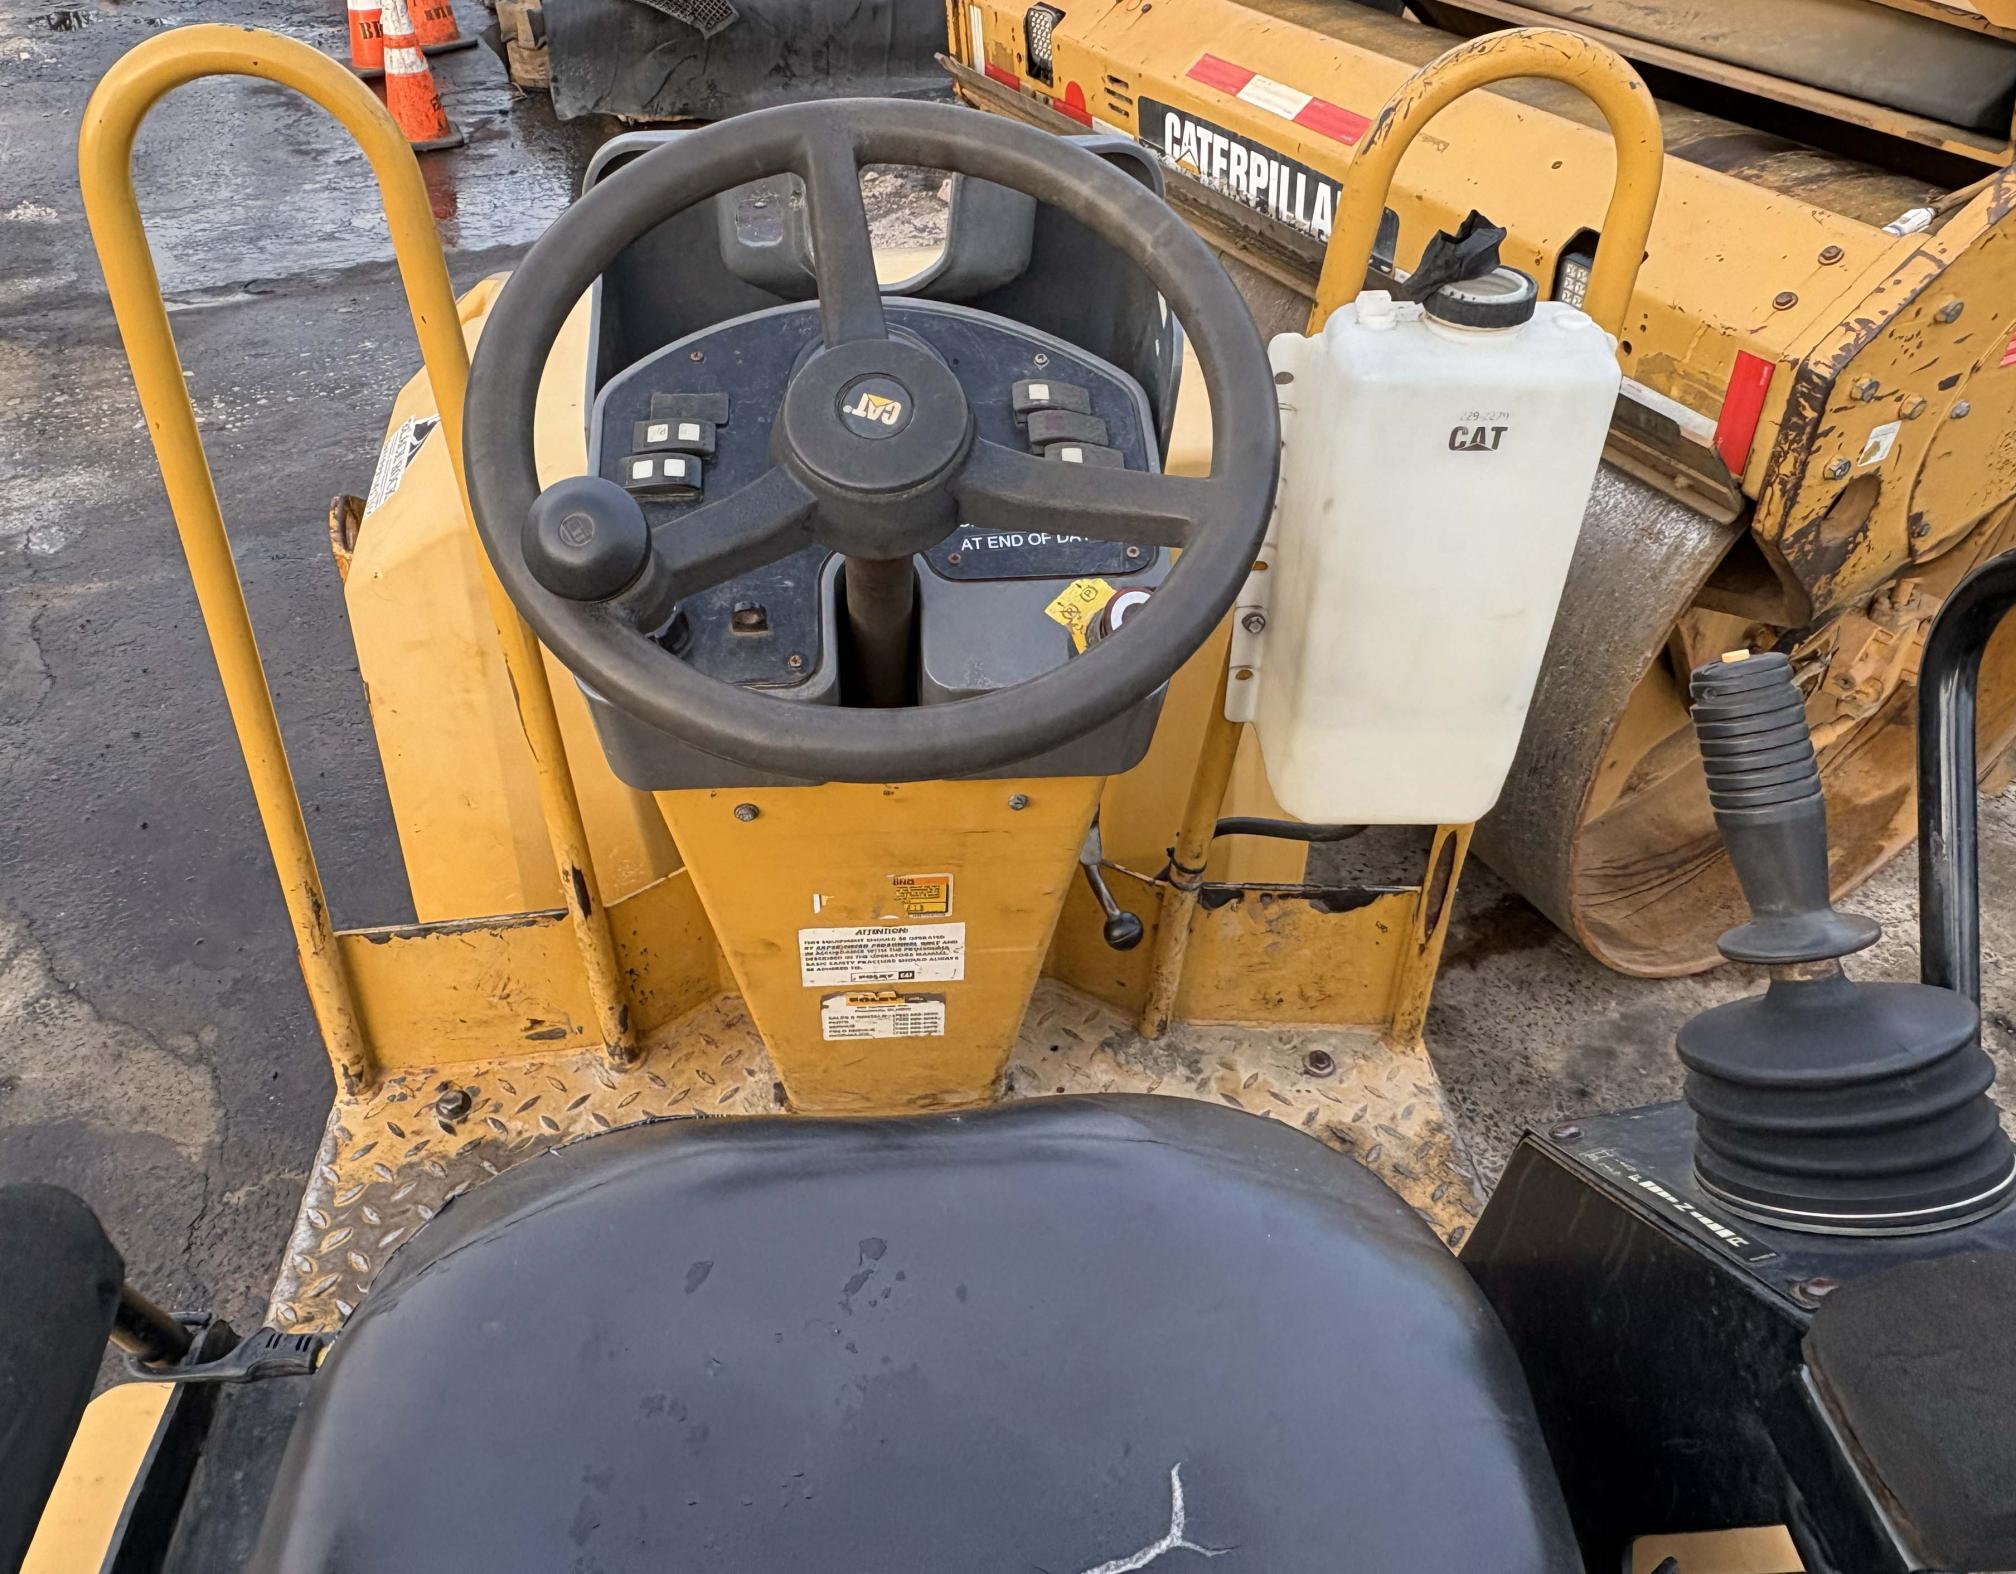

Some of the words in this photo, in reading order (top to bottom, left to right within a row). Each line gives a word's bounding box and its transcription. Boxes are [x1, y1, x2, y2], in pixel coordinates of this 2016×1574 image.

[1164, 111, 1341, 241] CATERPILLA
[852, 393, 901, 425] CAT
[1449, 426, 1508, 451] CAT
[961, 537, 982, 552] AT
[987, 534, 1024, 549] END
[1674, 1202, 1696, 1212] N
